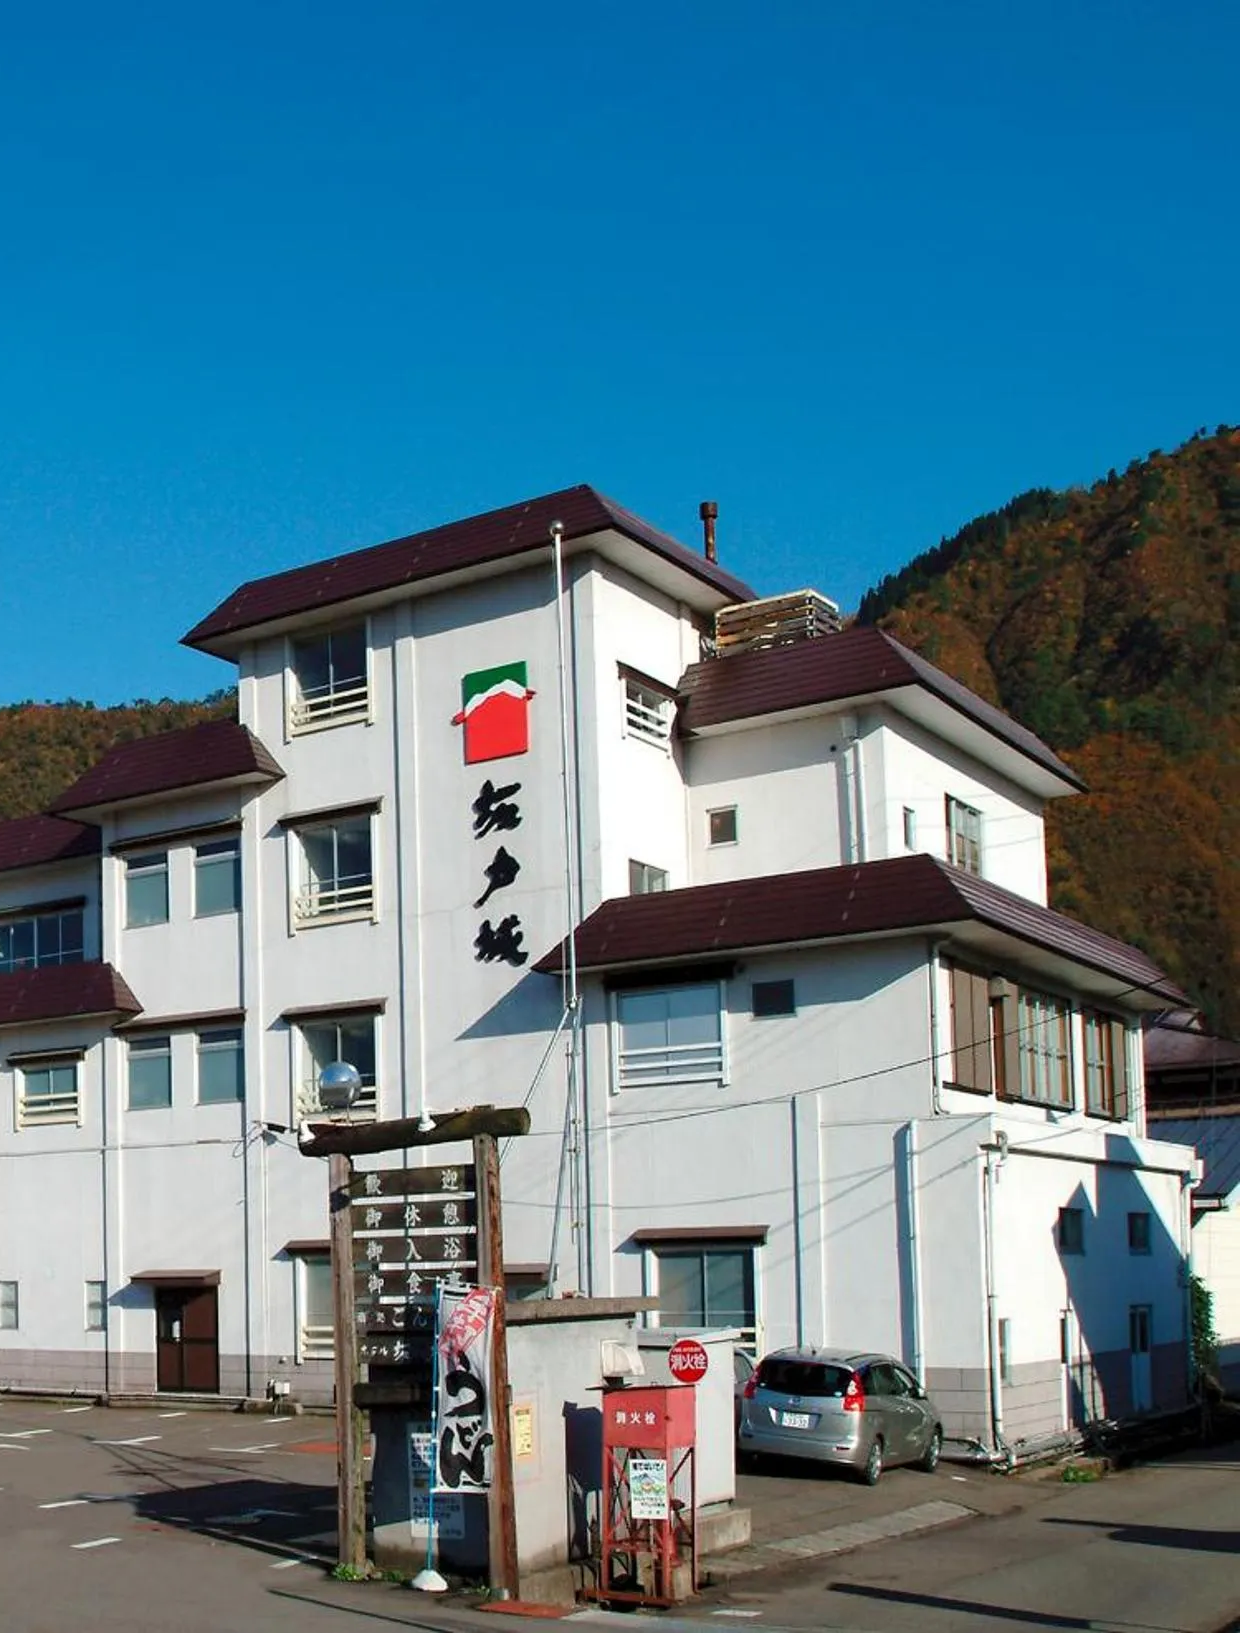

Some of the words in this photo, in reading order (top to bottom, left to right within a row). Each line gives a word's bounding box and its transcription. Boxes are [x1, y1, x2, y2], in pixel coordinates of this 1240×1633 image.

[364, 1202, 460, 1229] 御休憩
[365, 1236, 462, 1262] 御入浴
[670, 1353, 707, 1371] 消火栓
[439, 1350, 495, 1489] うどん
[615, 1410, 656, 1425] 消火栓
